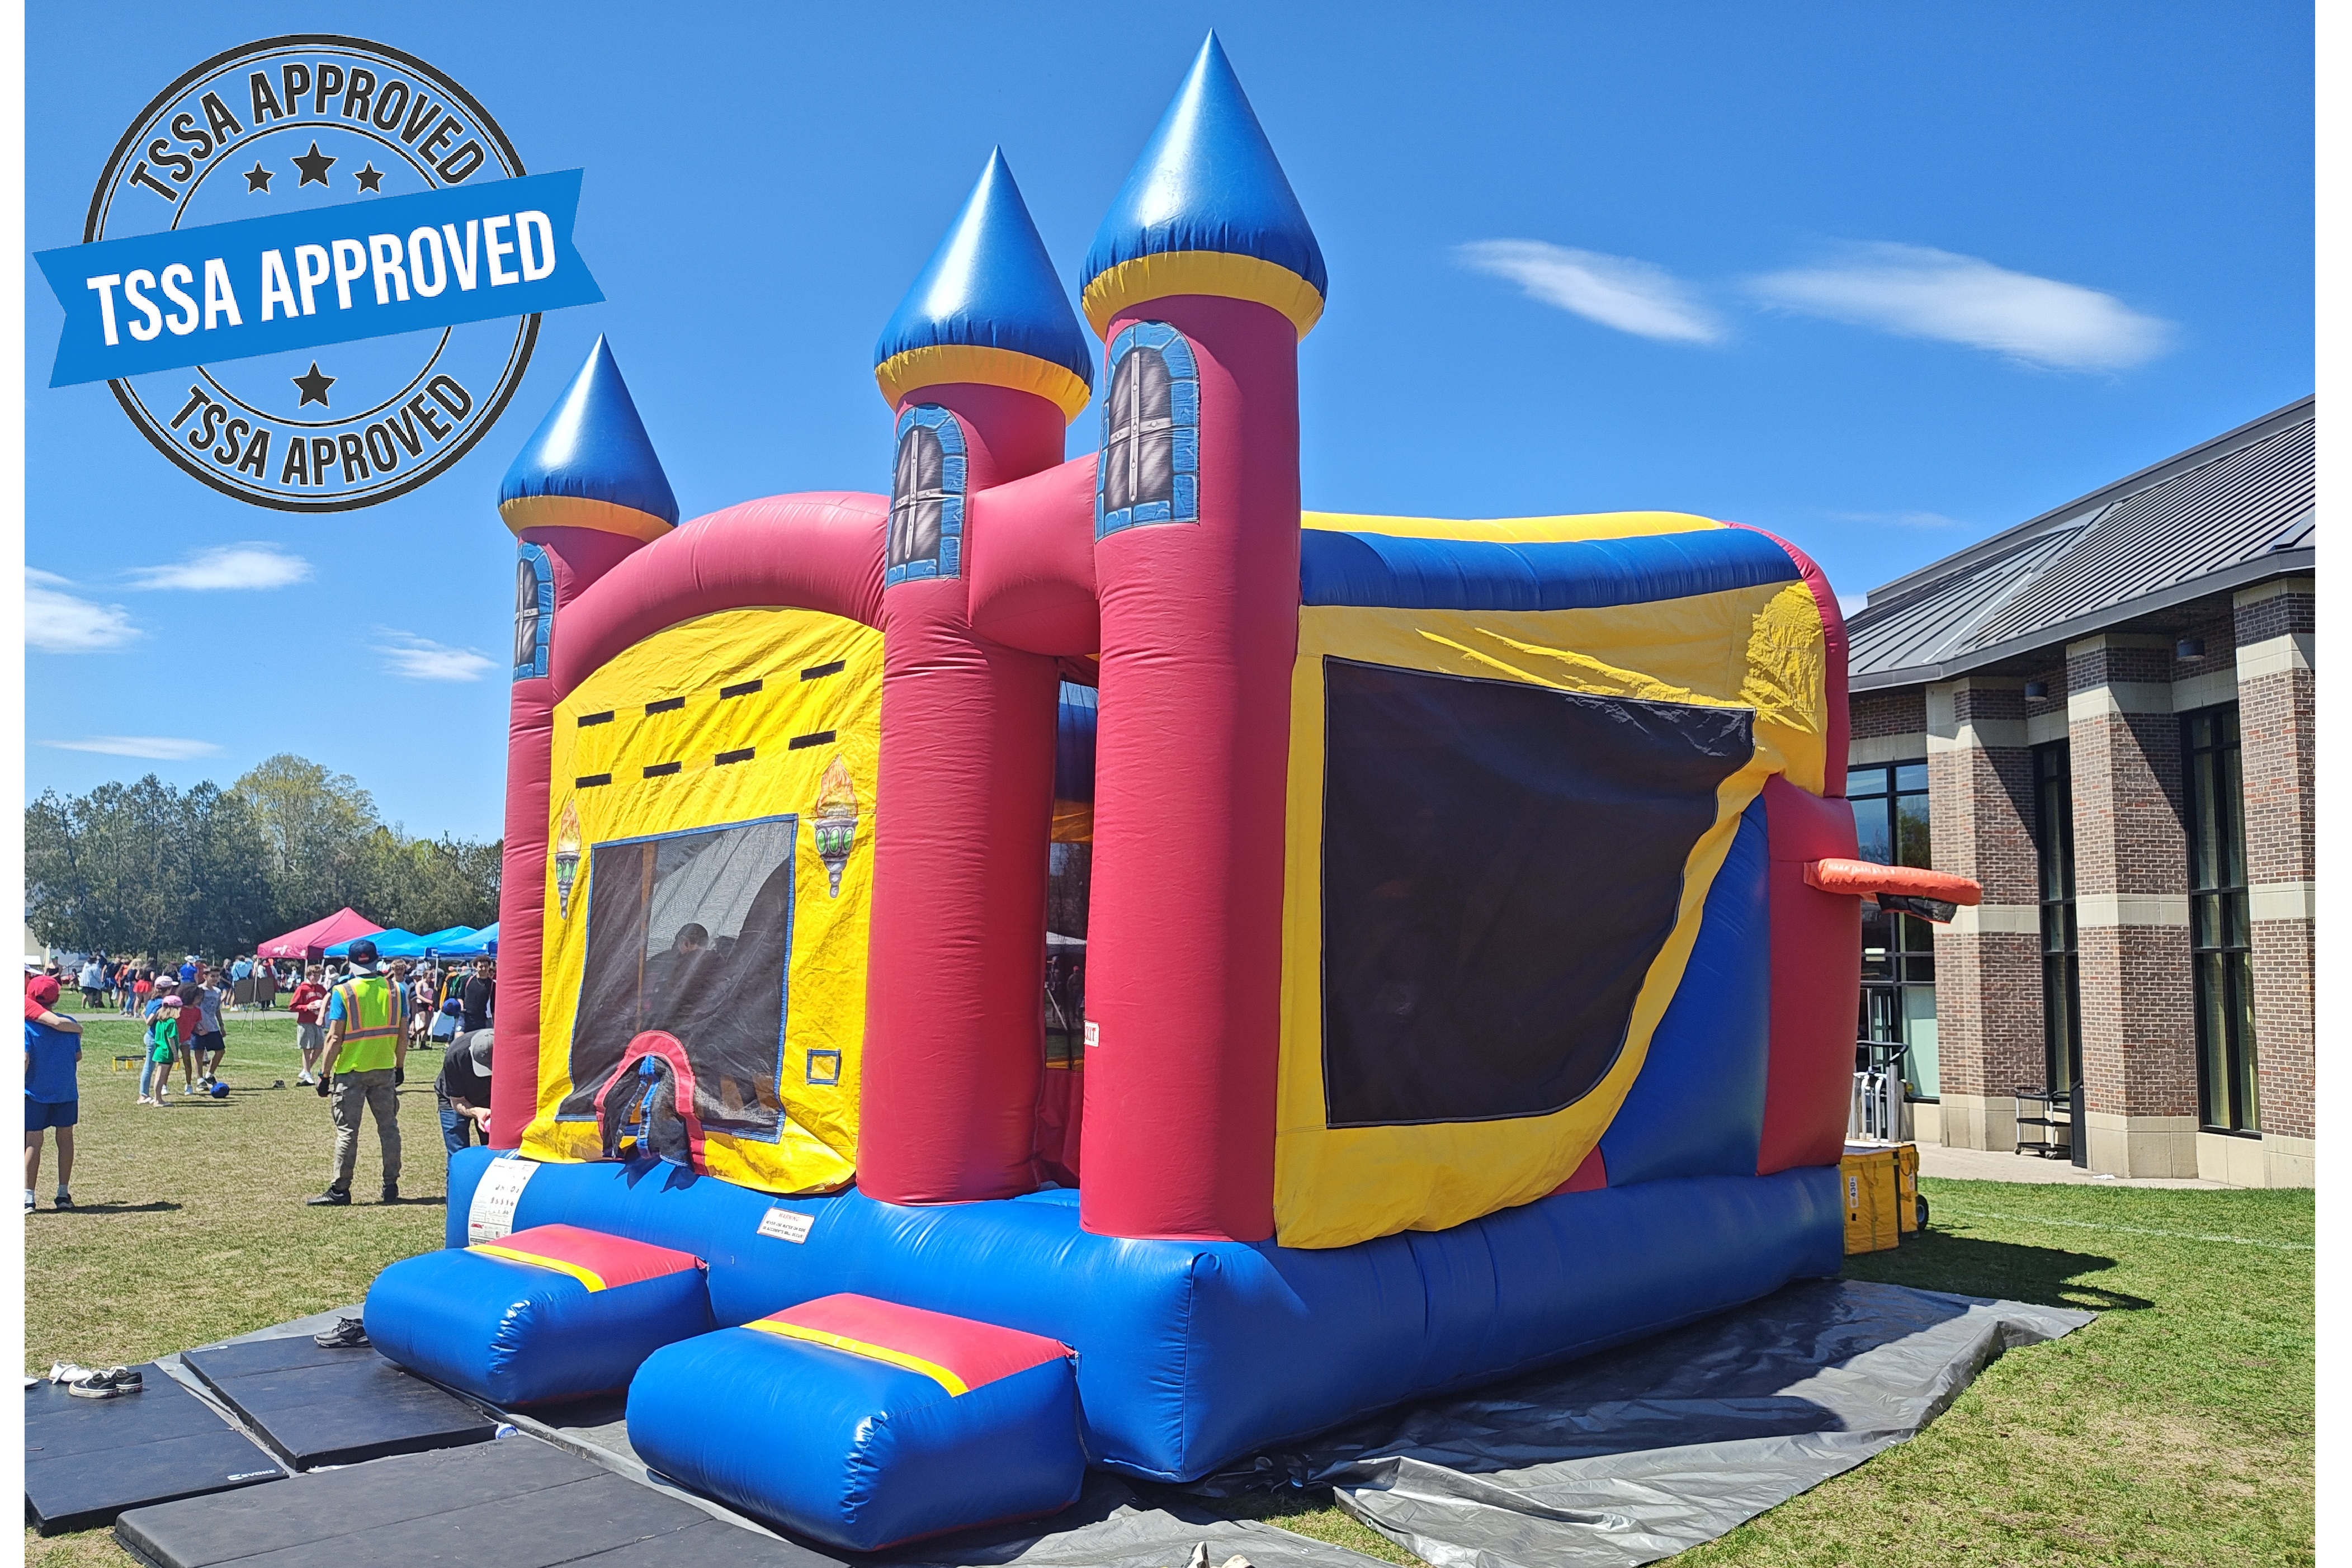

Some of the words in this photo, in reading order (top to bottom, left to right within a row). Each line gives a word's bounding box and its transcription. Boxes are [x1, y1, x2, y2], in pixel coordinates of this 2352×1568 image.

[1085, 1026, 1096, 1041] XIT
[778, 1213, 800, 1221] WARNING
[241, 1469, 276, 1478] EVOKE
